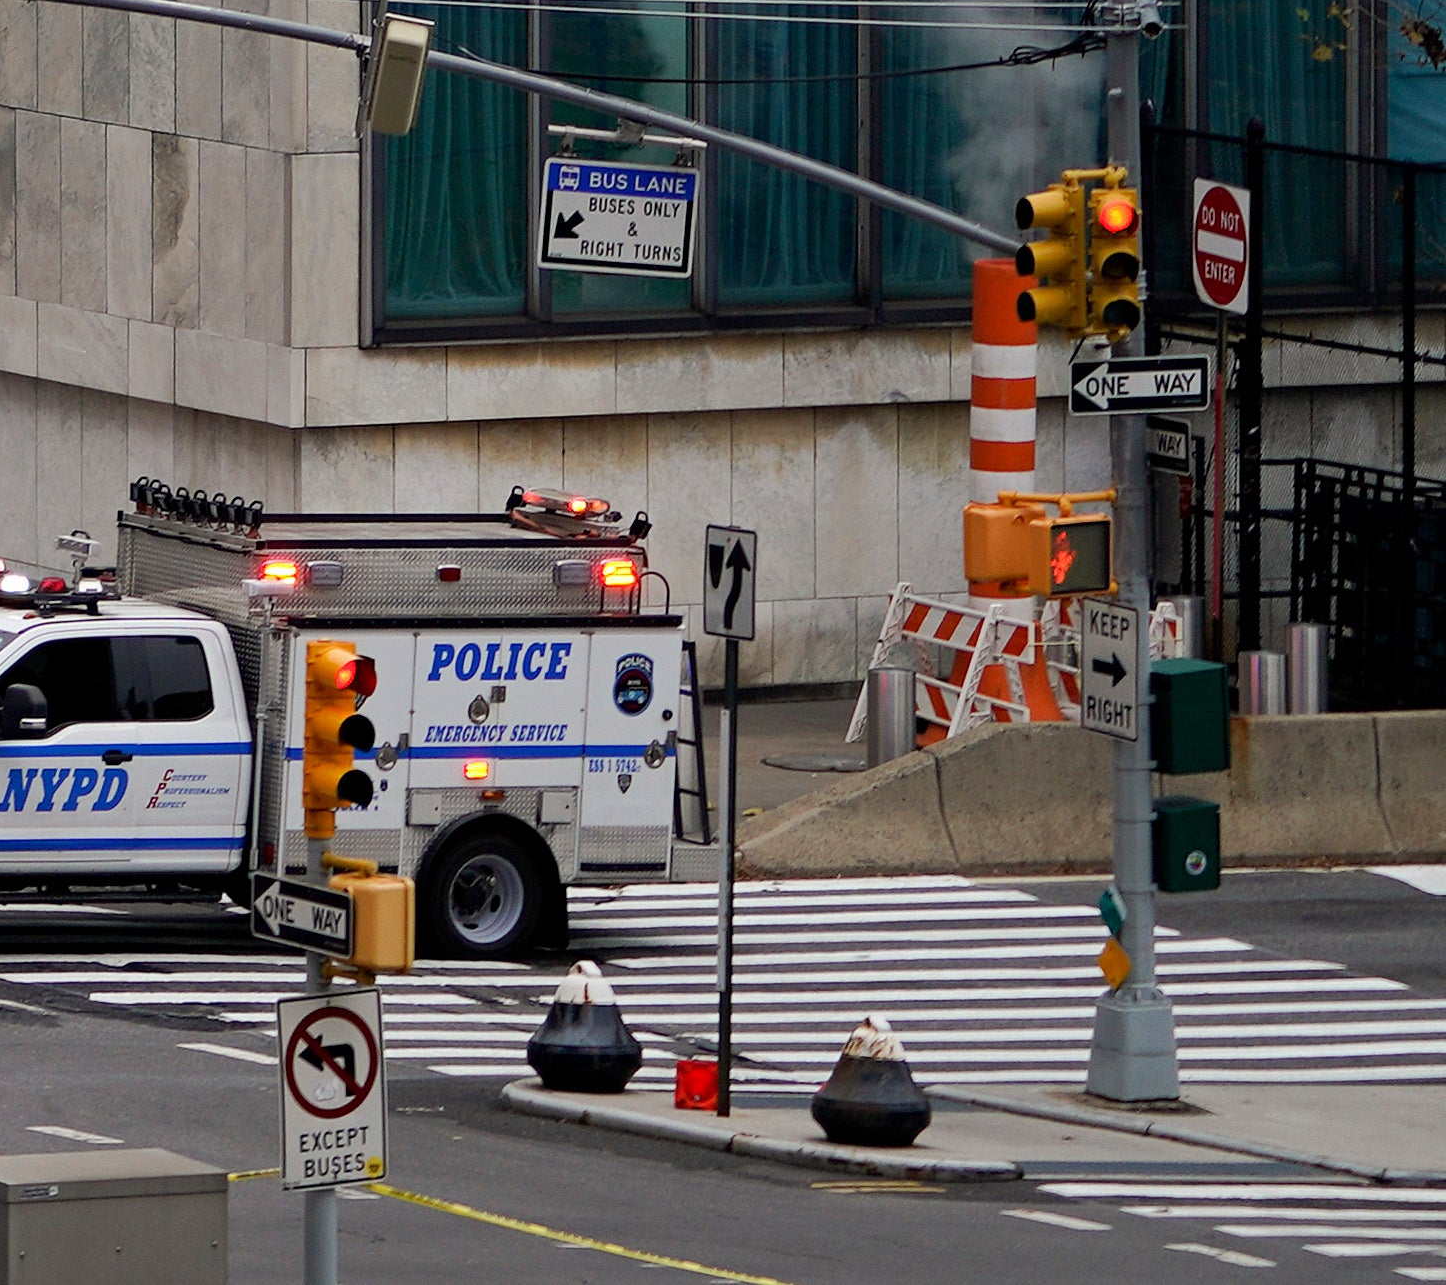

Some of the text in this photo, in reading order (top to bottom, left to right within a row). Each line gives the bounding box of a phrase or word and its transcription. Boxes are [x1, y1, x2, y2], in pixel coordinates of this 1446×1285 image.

[588, 171, 688, 195] BUS LANE
[588, 196, 682, 219] BUSES ONLY
[1201, 205, 1240, 233] DO NOT
[627, 221, 639, 237] &
[579, 239, 682, 263] RIGHT TURNS
[1204, 259, 1236, 286] ENTER
[1085, 373, 1196, 397] ONE WAY
[1155, 430, 1183, 456] WAY
[1090, 608, 1130, 641] KEEP
[427, 642, 573, 682] POLICE
[617, 656, 652, 673] POLICE
[1086, 694, 1133, 730] RIGHT
[424, 724, 568, 744] EMERGENCY SERVICE
[588, 758, 604, 773] ESS
[616, 758, 637, 773] 5742
[262, 895, 343, 932] ONE WAY
[298, 1124, 370, 1153] EXCEPT
[303, 1152, 367, 1179] BUSES
